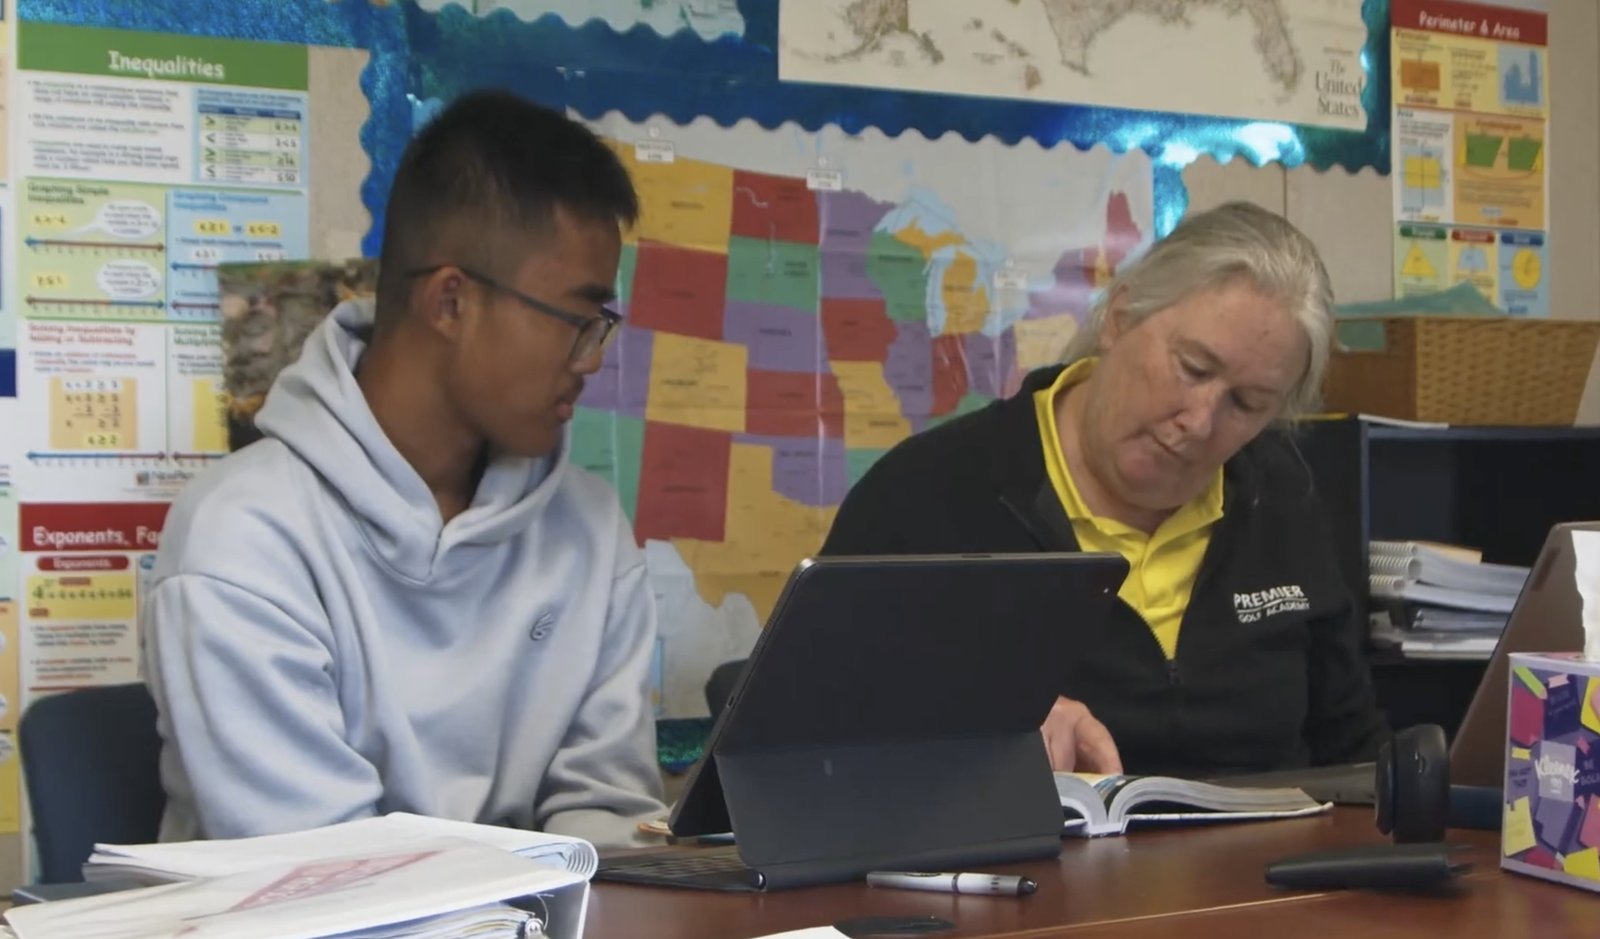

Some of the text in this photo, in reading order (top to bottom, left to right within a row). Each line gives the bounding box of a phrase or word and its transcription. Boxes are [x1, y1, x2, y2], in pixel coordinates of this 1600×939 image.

[1419, 10, 1477, 32] Perimeter
[1493, 22, 1520, 39] Area
[108, 50, 226, 79] Inequalities
[1315, 71, 1362, 95] United
[1317, 94, 1360, 117] States
[33, 526, 131, 550] Exponents,
[1233, 585, 1305, 608] PREMIER
[1238, 602, 1310, 623] GOLF ACADEMY
